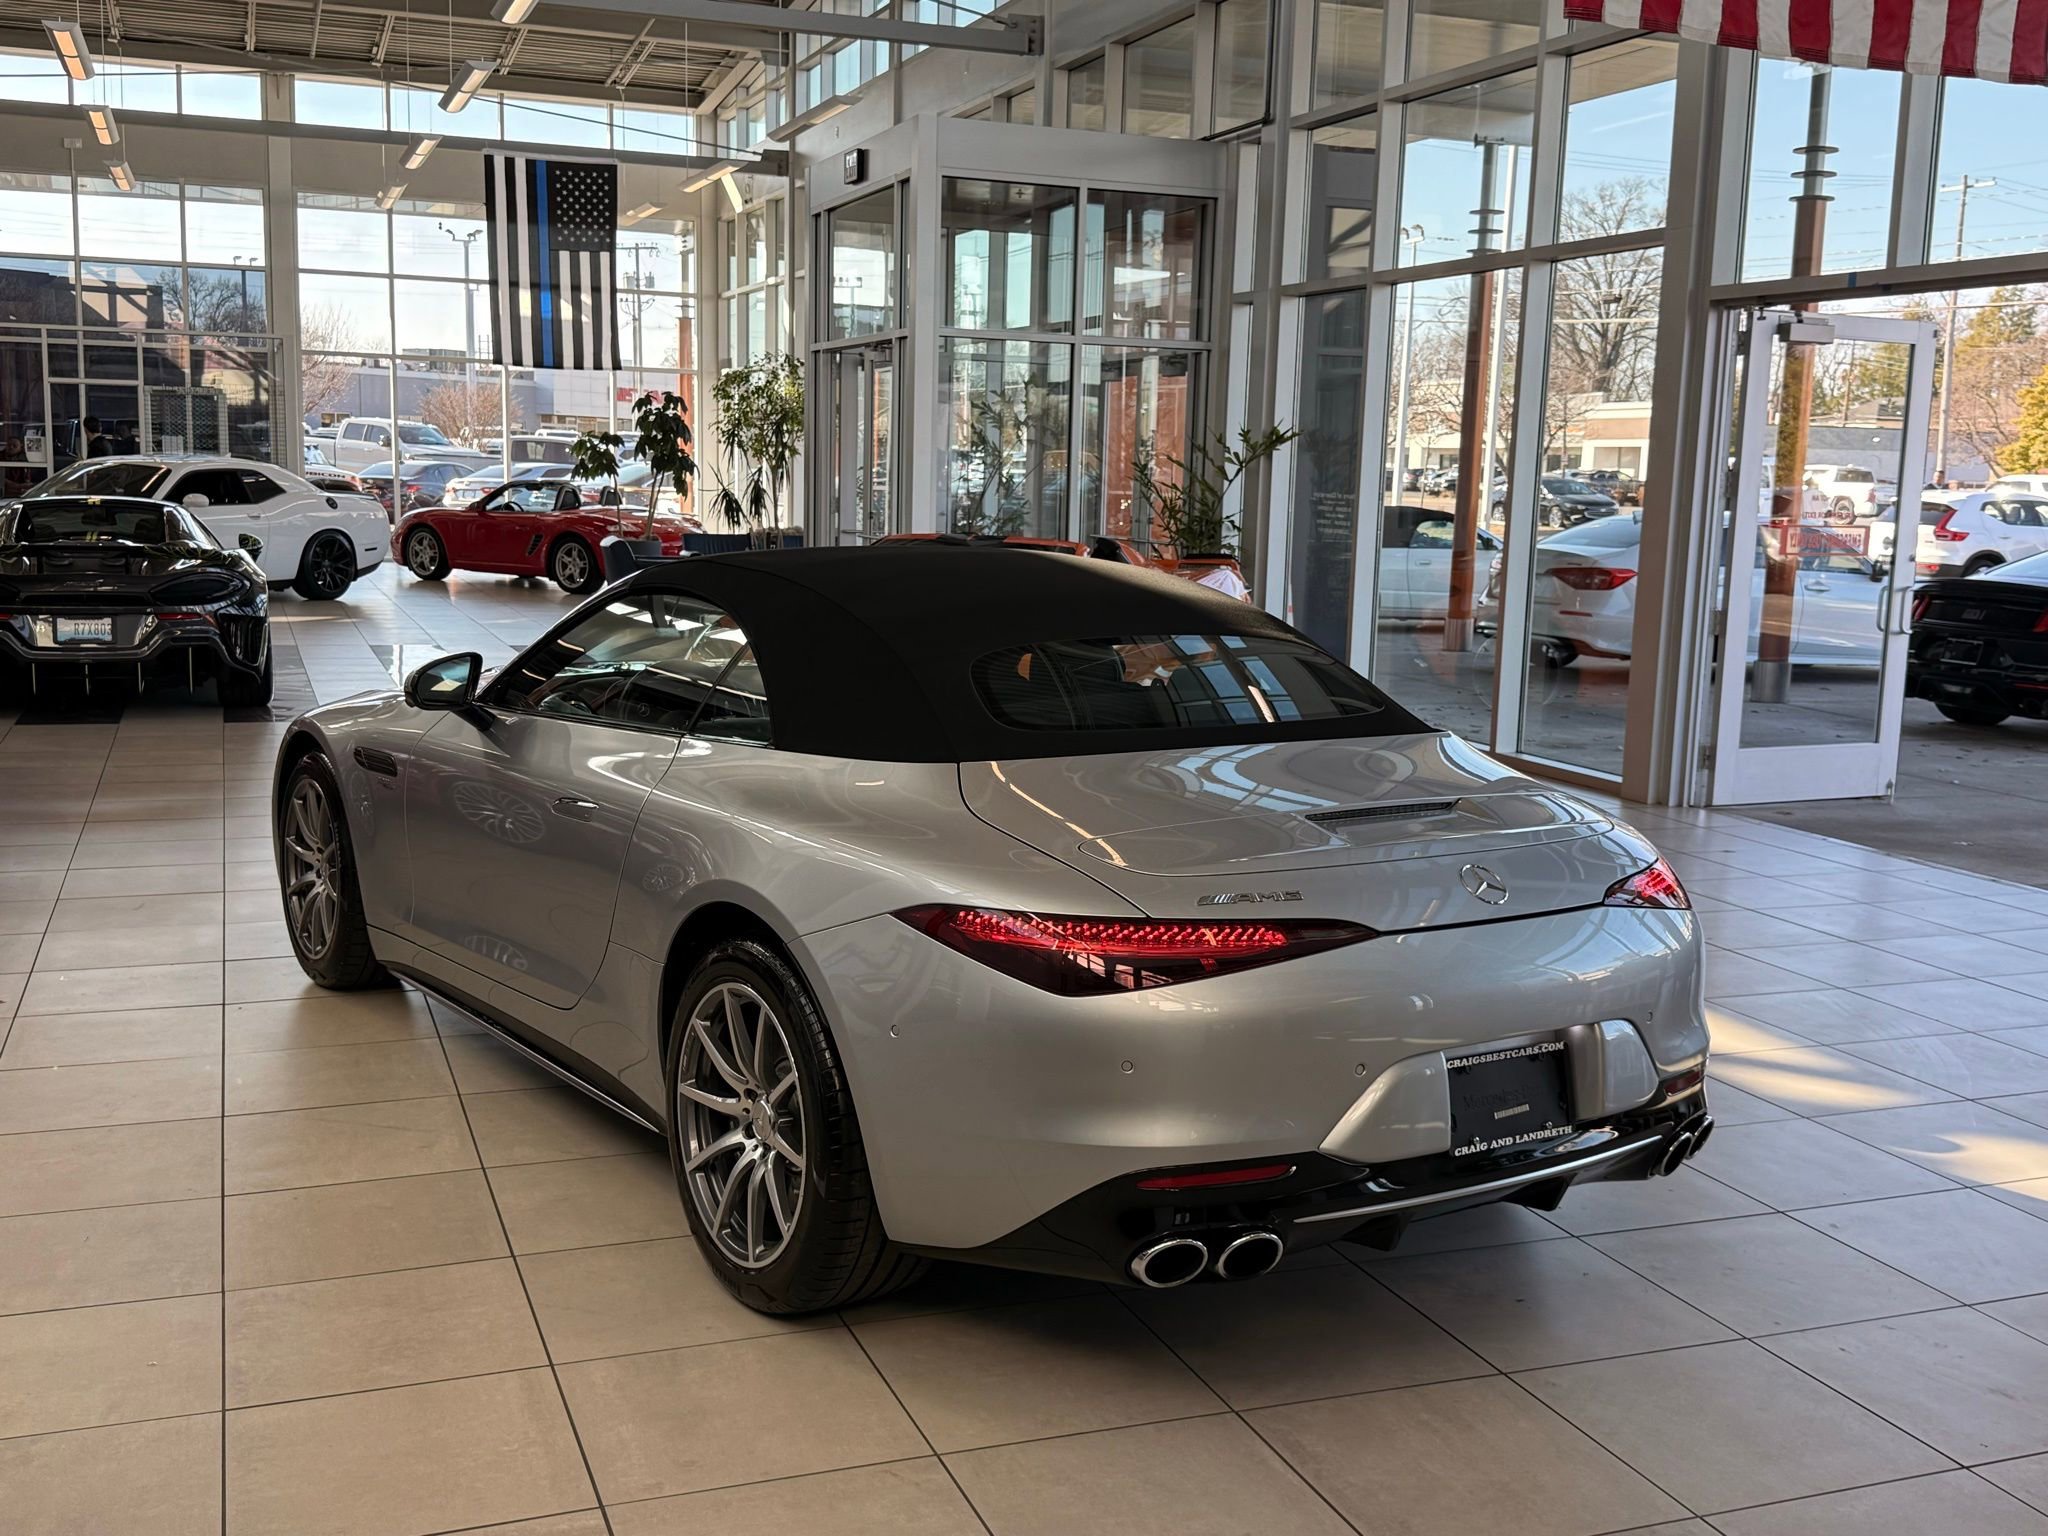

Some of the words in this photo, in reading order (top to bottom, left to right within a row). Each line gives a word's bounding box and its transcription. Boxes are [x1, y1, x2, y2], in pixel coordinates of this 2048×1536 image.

[1447, 1041, 1565, 1069] CRAIGSBESTCARS.COM
[1454, 1141, 1488, 1157] CRAIG
[1490, 1136, 1514, 1149] AND
[1515, 1125, 1573, 1144] LANDRETH
